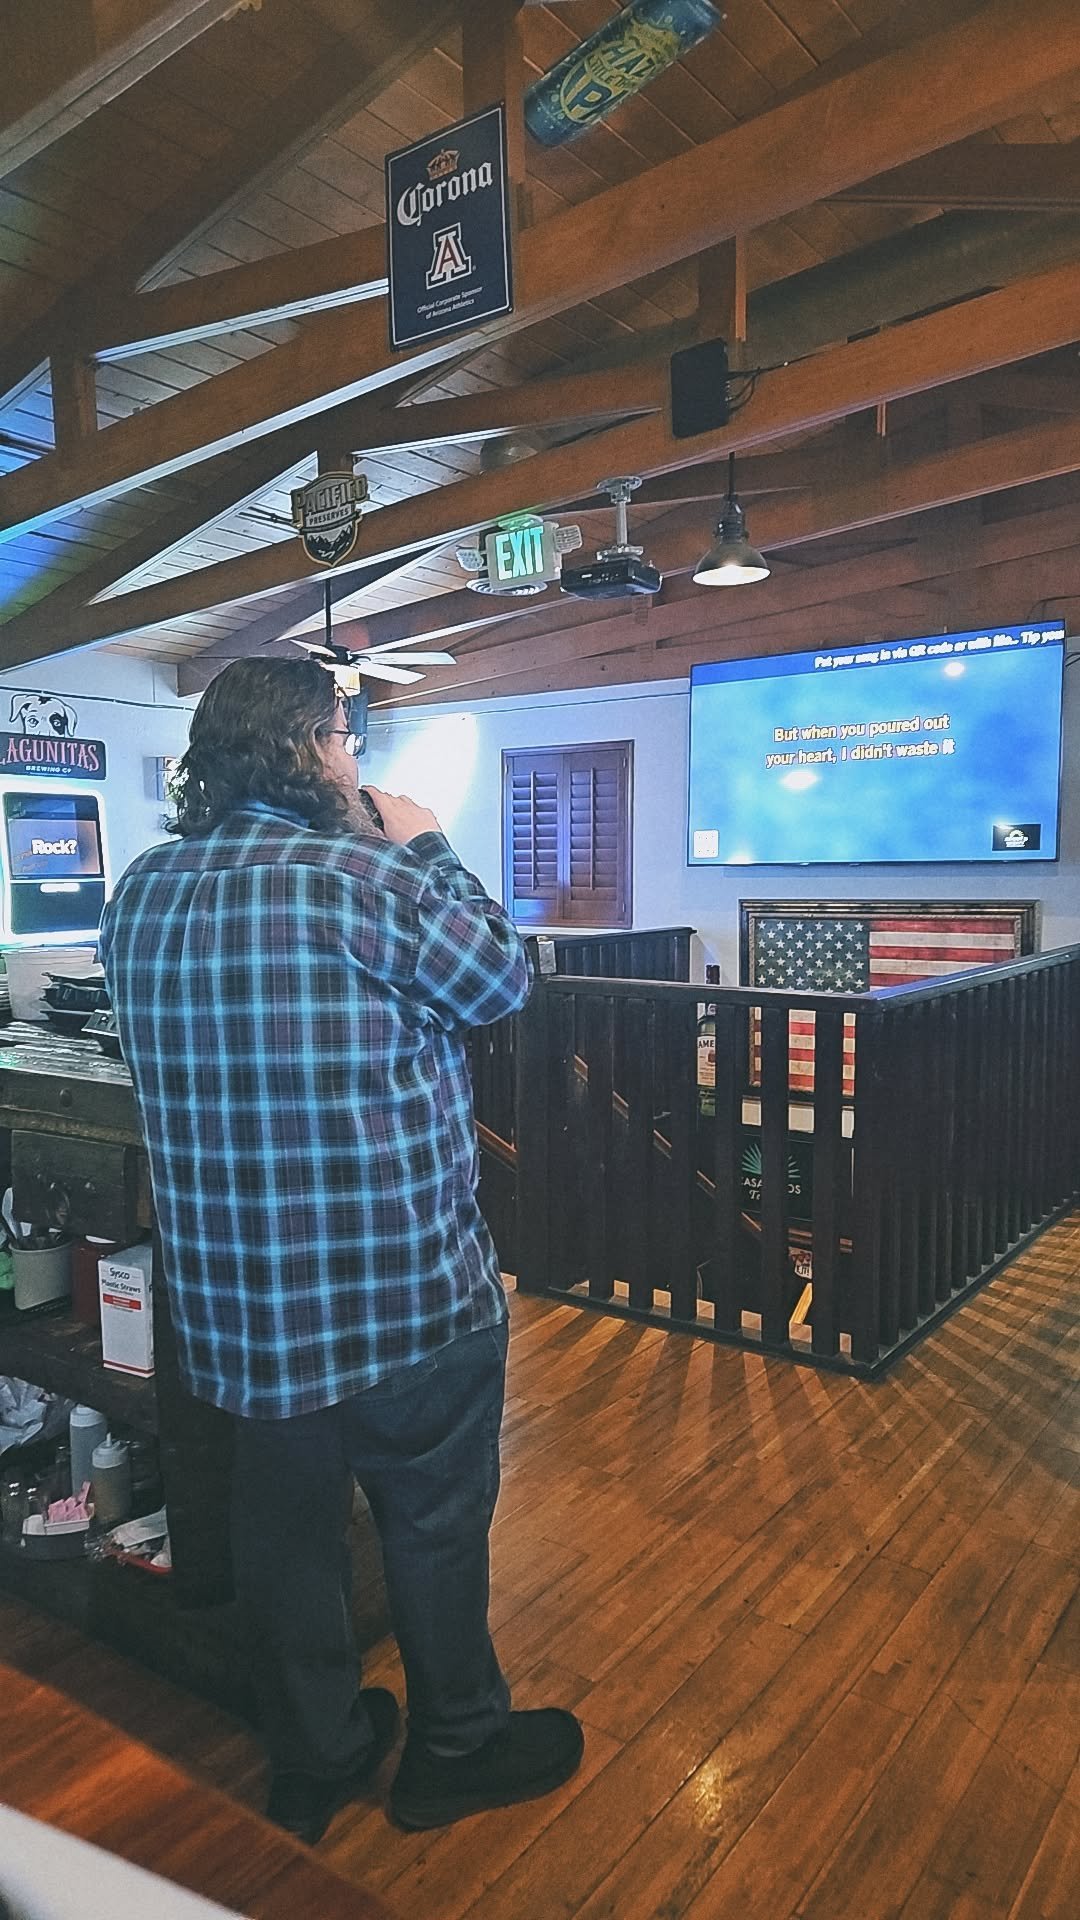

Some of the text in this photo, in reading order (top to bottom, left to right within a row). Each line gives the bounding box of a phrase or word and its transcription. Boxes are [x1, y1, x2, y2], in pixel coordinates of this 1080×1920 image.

[601, 38, 656, 79] HAZ
[397, 162, 493, 227] Corona
[426, 222, 473, 290] A
[292, 475, 368, 528] PACIFICO
[308, 507, 350, 526] PRESERVES
[495, 525, 545, 581] EXIT
[1020, 631, 1041, 645] Tip
[774, 714, 950, 742] But when you poured out
[0, 737, 100, 772] AGUNITAS
[766, 738, 956, 769] your heart, I didn't waste it
[25, 765, 60, 773] BREWING
[32, 839, 77, 854] Rock?
[109, 1267, 130, 1280] Sysco
[120, 1283, 142, 1294] Straws
